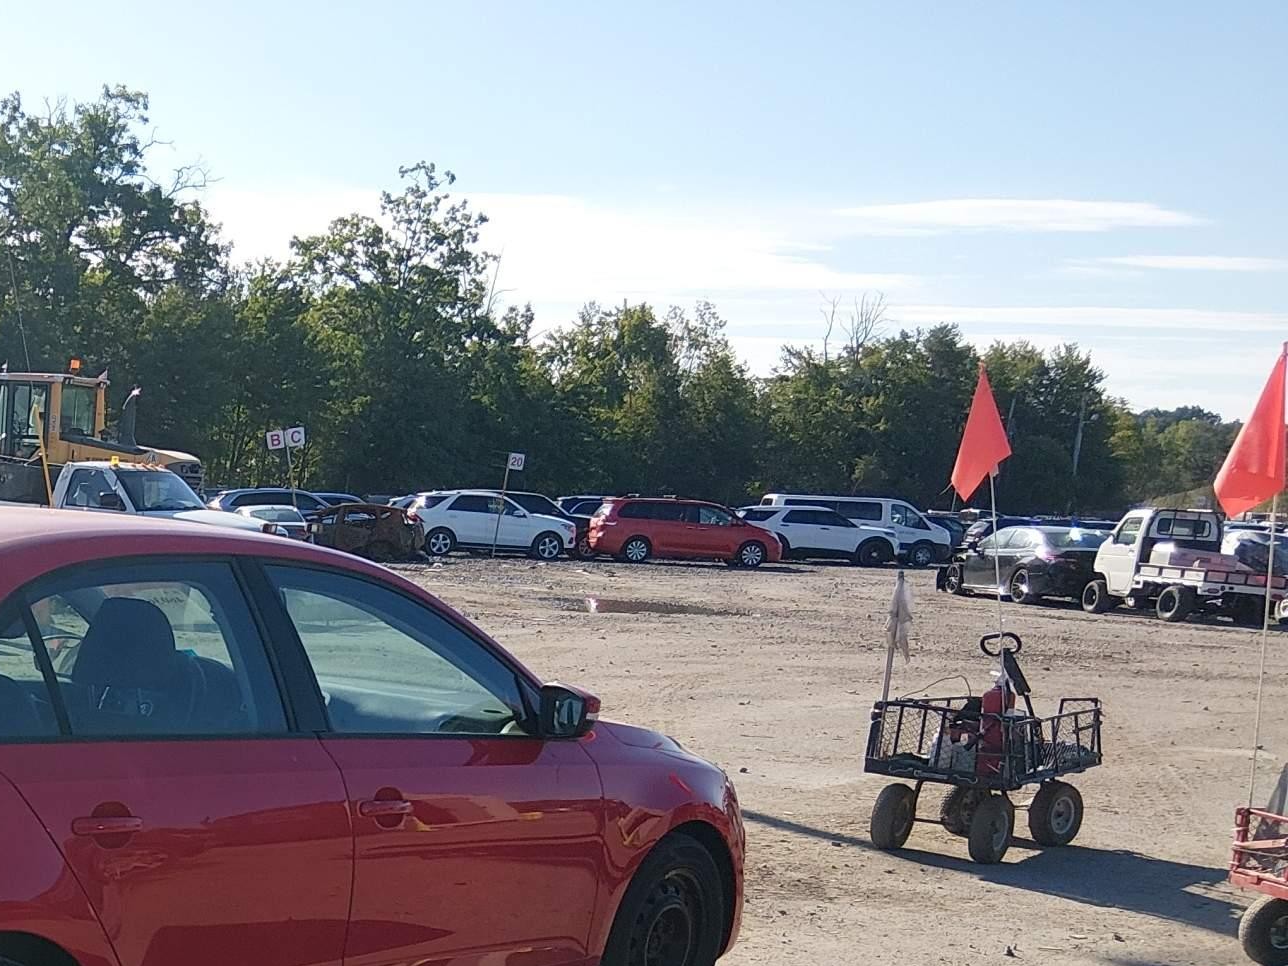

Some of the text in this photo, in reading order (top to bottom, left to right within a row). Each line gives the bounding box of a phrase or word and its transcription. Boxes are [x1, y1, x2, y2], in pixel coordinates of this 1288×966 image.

[270, 434, 281, 447] B
[291, 431, 302, 444] C
[511, 456, 522, 467] 20
